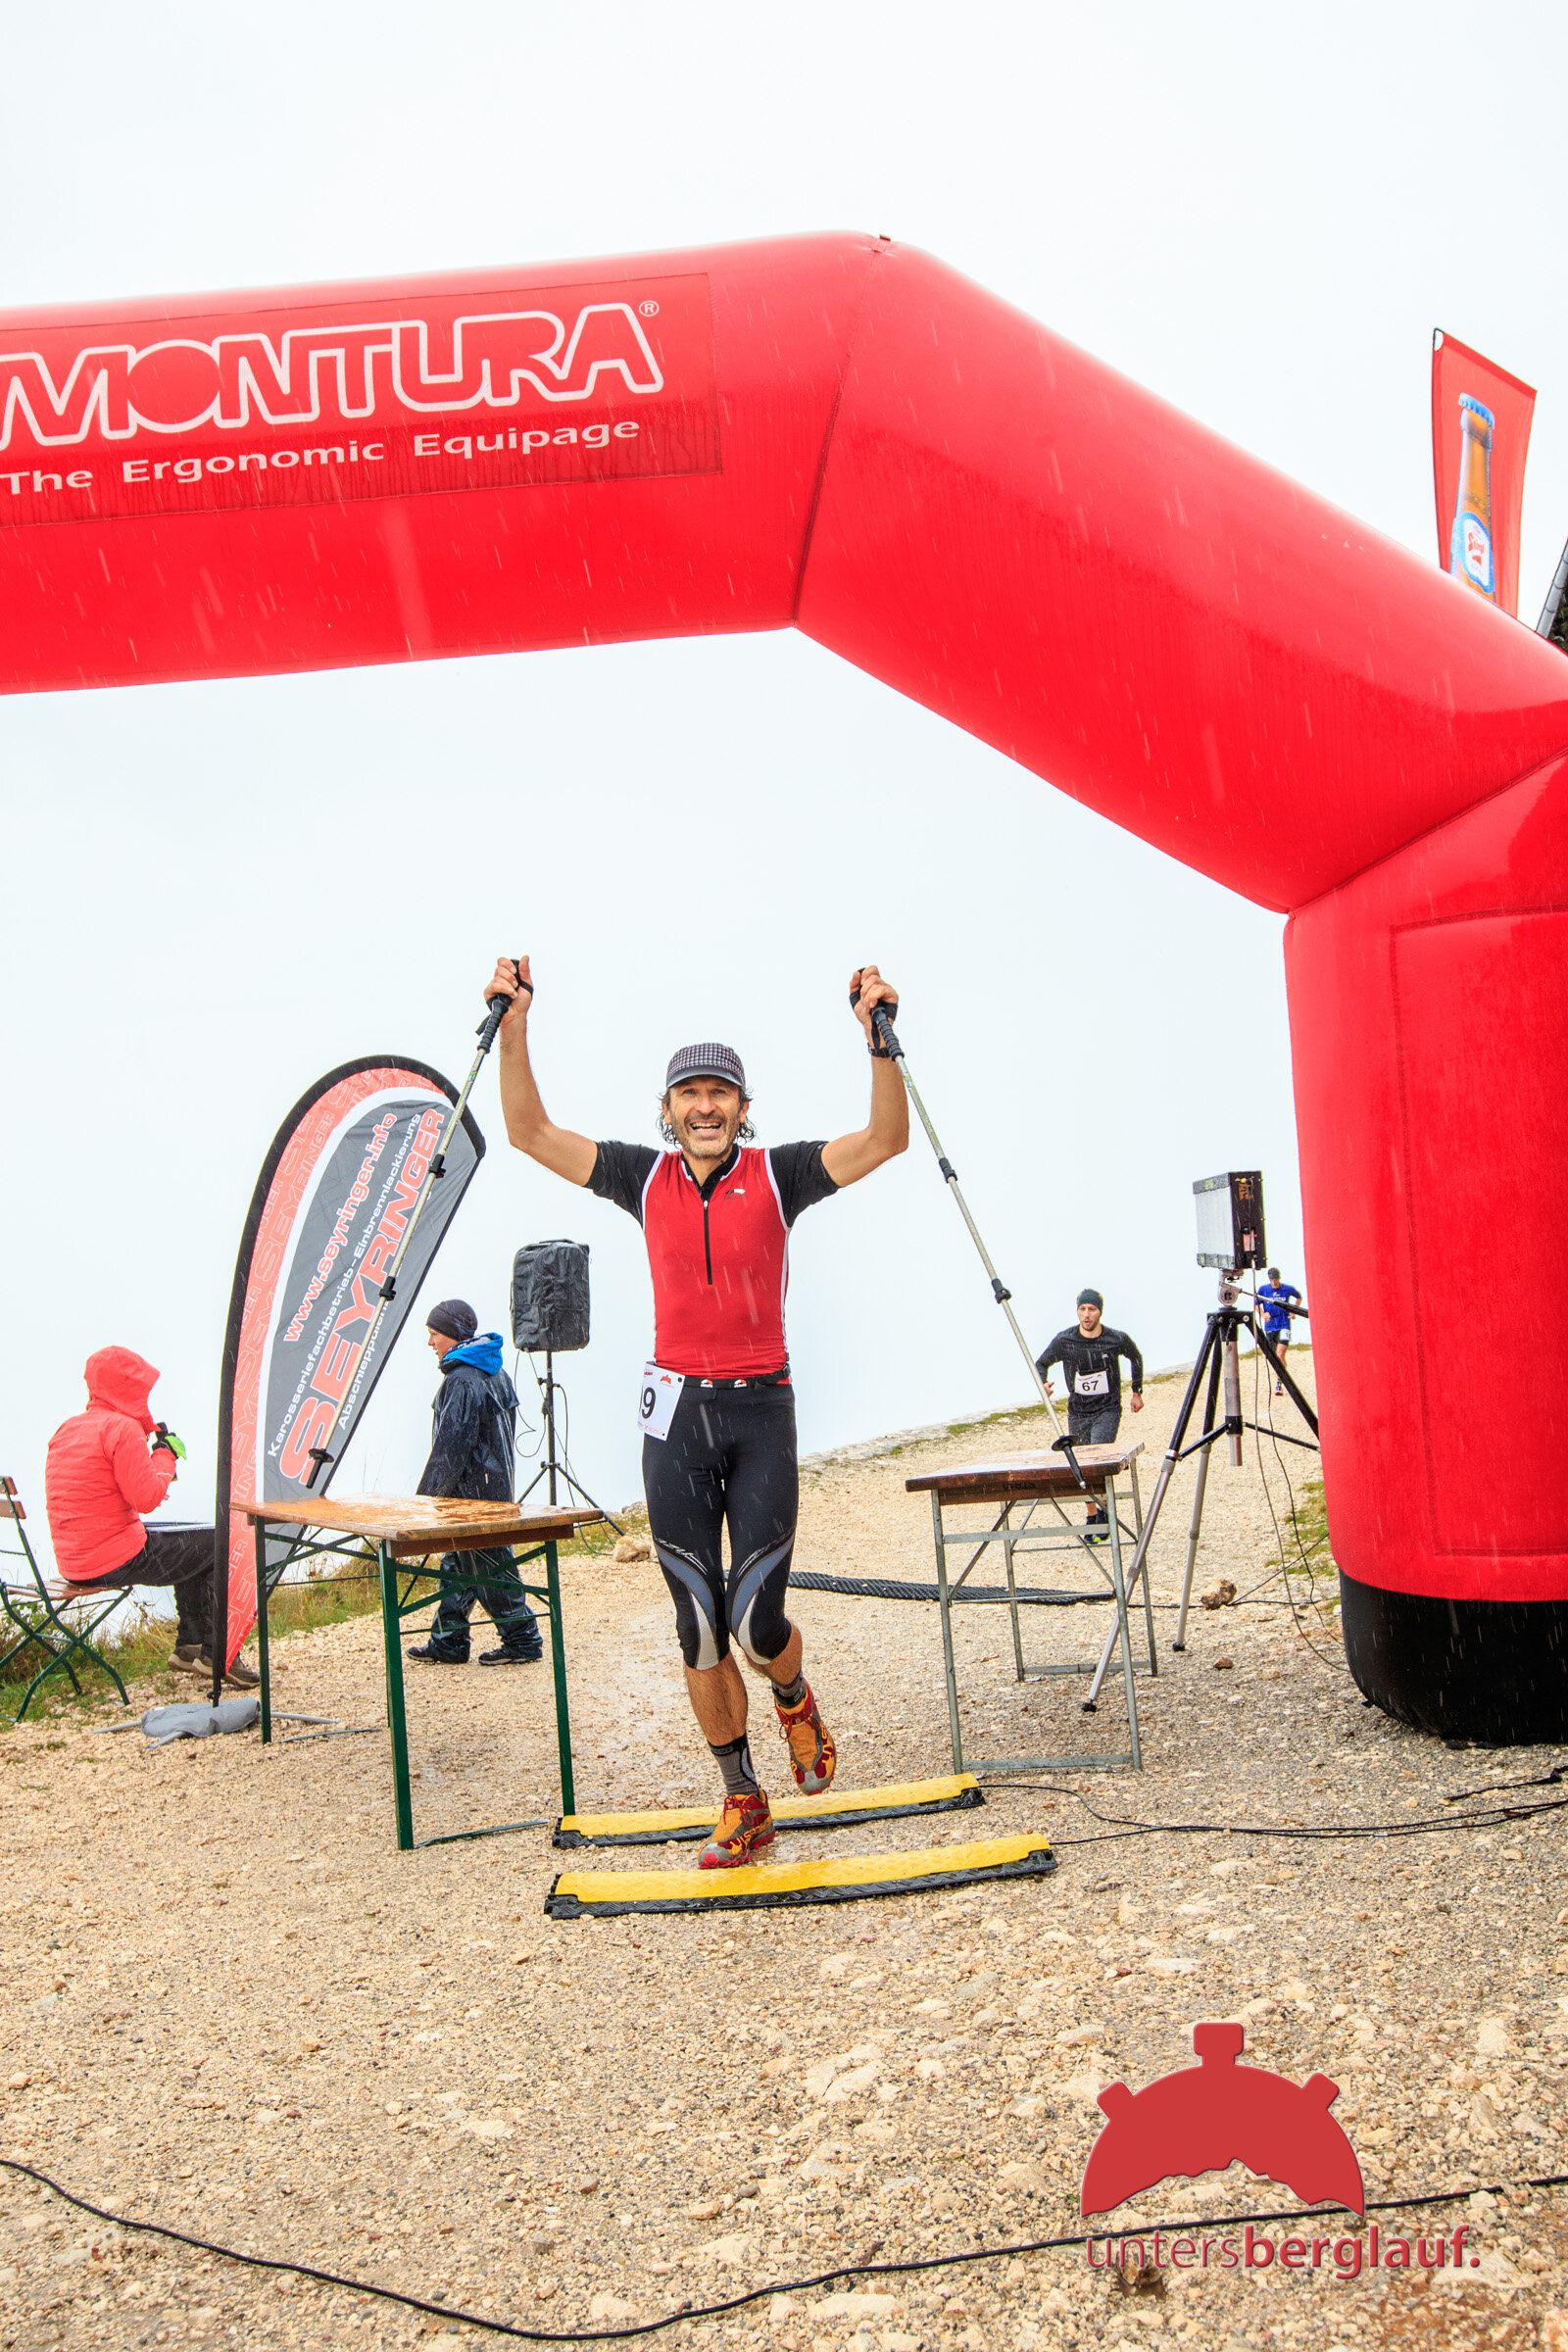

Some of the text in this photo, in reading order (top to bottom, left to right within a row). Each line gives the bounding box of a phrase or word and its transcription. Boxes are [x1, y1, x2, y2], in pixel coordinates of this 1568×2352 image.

[0, 422, 640, 495] The Ergonomic Equipage
[283, 1111, 398, 1343] www.seyringer.info
[278, 1106, 445, 1486] SEYRINGER
[639, 1387, 657, 1419] 9
[1081, 1380, 1099, 1392] 67
